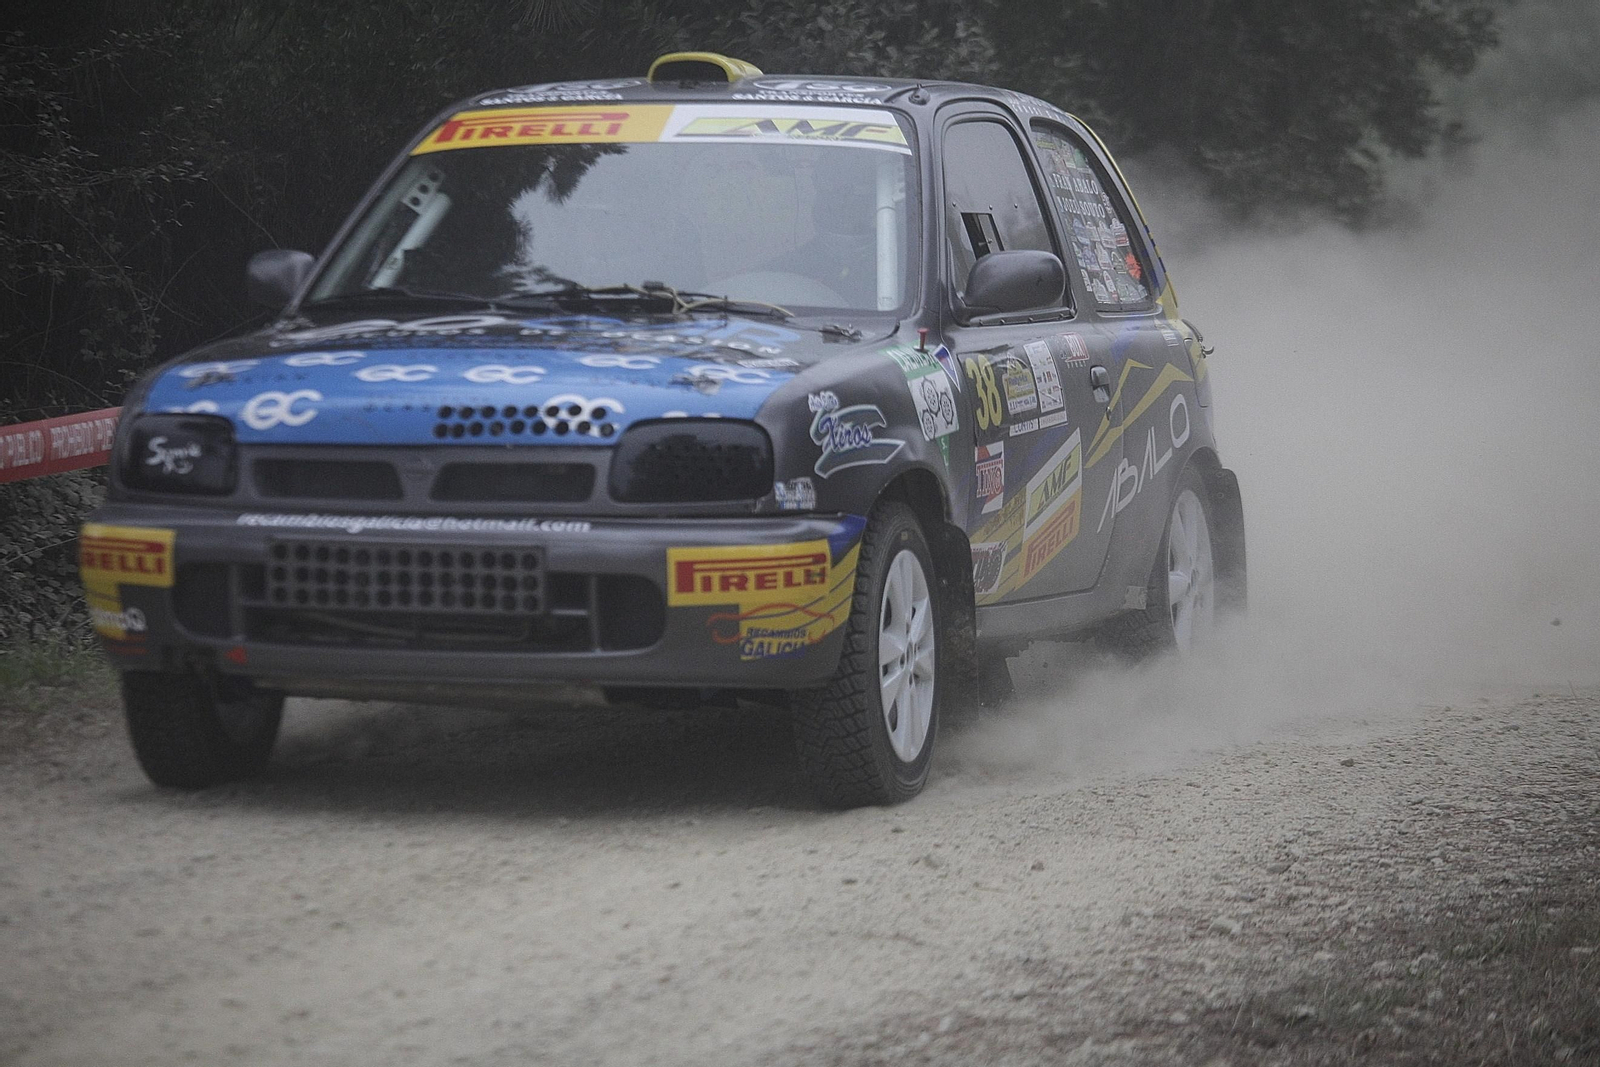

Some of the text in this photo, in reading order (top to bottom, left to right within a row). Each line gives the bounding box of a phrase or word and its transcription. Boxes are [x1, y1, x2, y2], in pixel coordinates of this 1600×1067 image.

[434, 113, 630, 143] PIRELLI
[724, 119, 892, 138] AMF
[1072, 177, 1098, 194] ABALO
[965, 353, 1002, 430] 38
[1036, 455, 1073, 511] AMF
[1023, 499, 1077, 578] PIRELLI
[675, 553, 827, 593] PIRELLI
